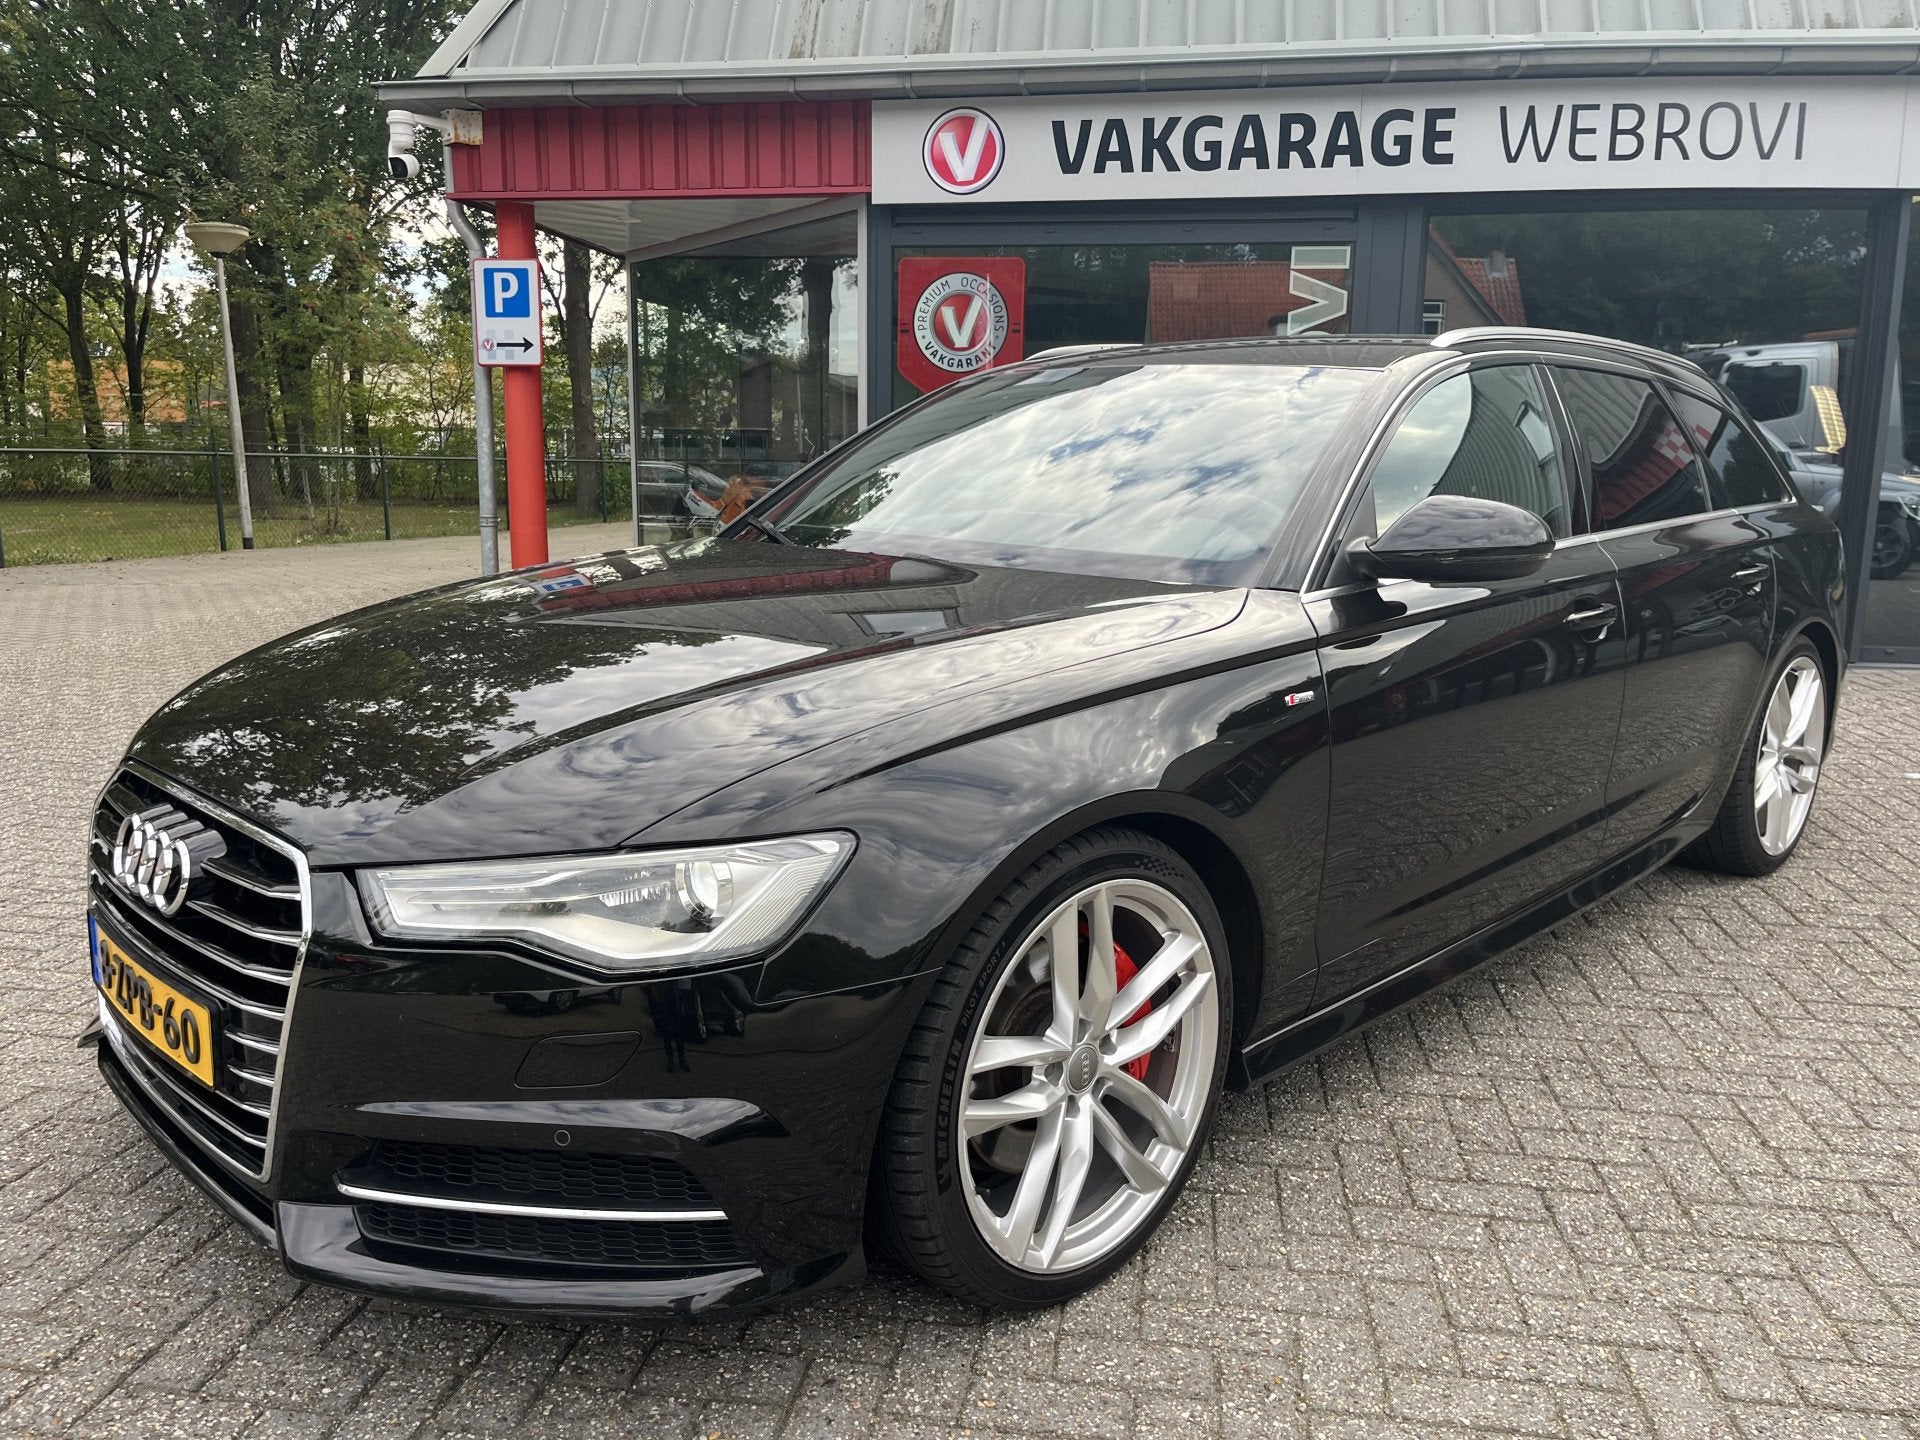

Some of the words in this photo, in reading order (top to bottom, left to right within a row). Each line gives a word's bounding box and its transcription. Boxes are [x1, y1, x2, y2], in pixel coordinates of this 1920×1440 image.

[1051, 107, 1457, 175] VAKGARAGE
[1499, 101, 1808, 164] WEBROVI
[493, 272, 519, 313] P
[917, 280, 951, 331] PREMIUM
[937, 1038, 963, 1159] MICHELIN
[961, 992, 979, 1027] PILOT
[979, 950, 1002, 989] SPORT
